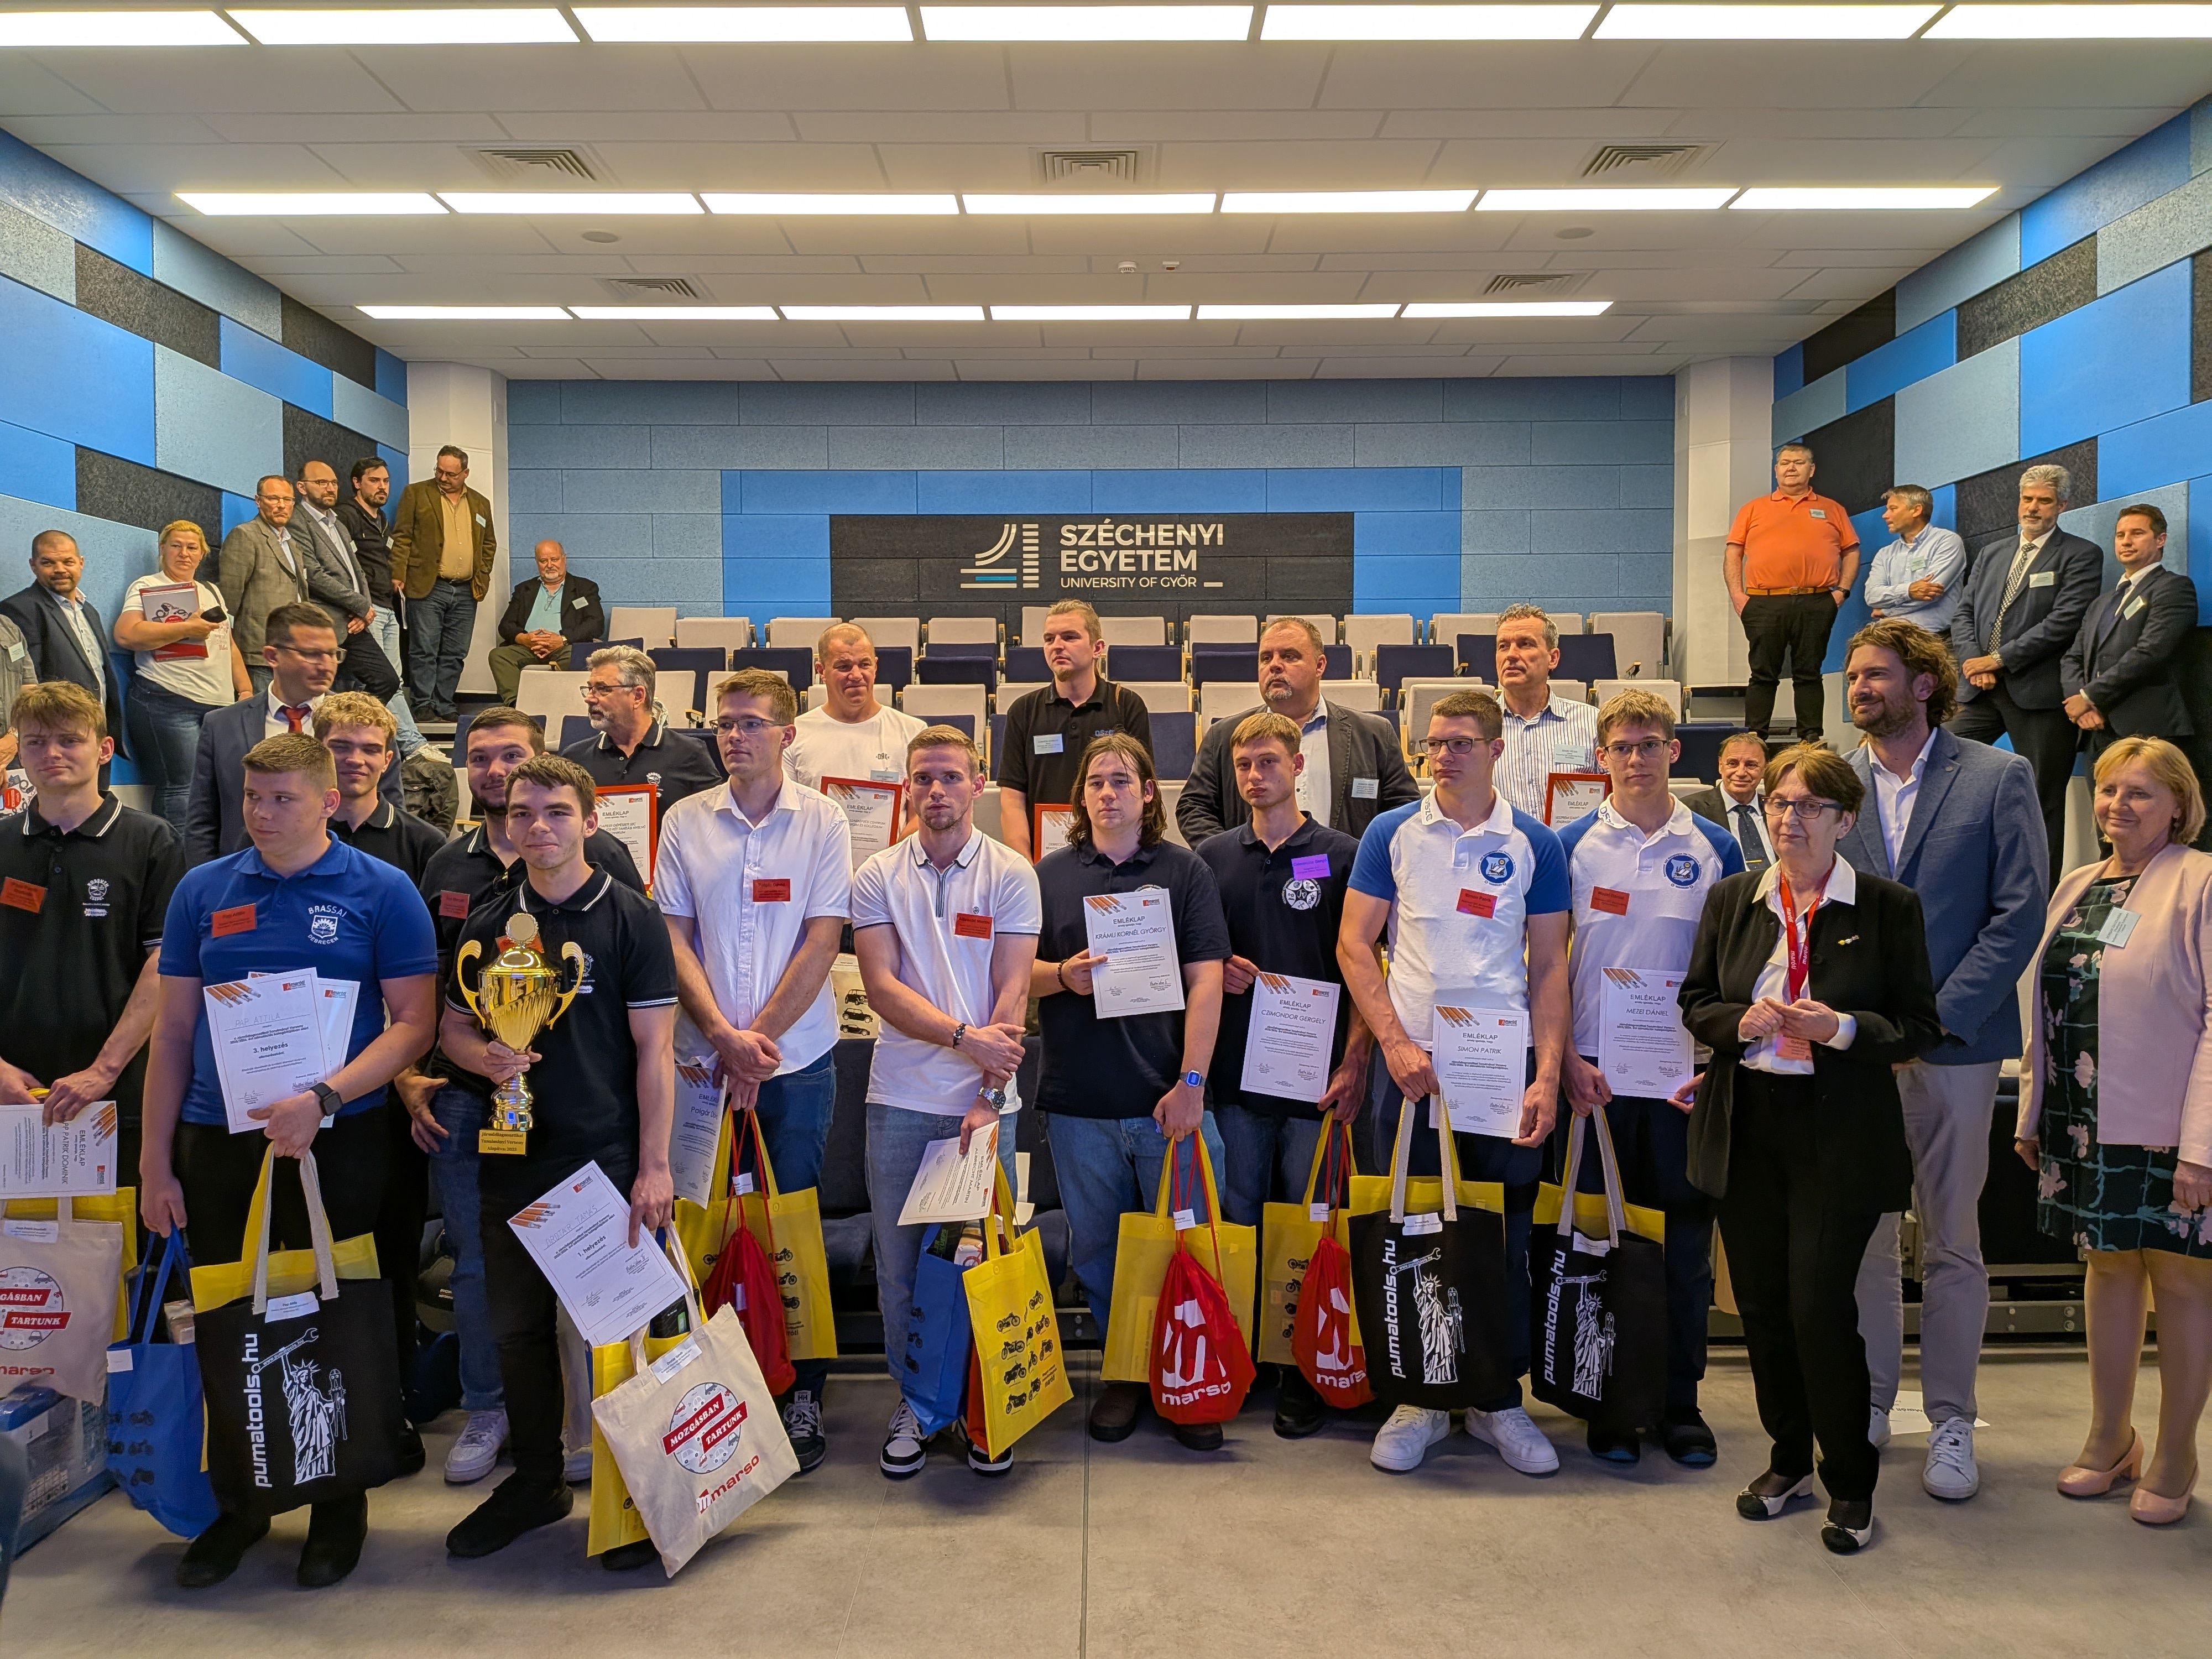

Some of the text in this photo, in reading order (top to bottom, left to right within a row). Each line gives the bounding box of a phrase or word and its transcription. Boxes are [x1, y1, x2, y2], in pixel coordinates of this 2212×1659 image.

[1060, 518, 1223, 546] SZÉCHENYI
[1061, 550, 1197, 571] EGYETEM
[1061, 574, 1197, 588] UNIVERSITY OF GYŐR
[308, 905, 347, 917] BRASSAI
[1113, 916, 1145, 925] EMLÉKLAP
[307, 934, 339, 945] DEBRECEN
[1117, 929, 1140, 938] KORNÉL
[1279, 999, 1311, 1009] EMLÉKLAP
[1261, 1009, 1327, 1024] CZIMONDOR GERGELY
[260, 1042, 288, 1052] helyezés
[964, 1147, 978, 1203] ALBRECHT MARTIN
[583, 1235, 607, 1254] helyezés
[11, 1317, 61, 1326] TARTUNK
[1317, 1369, 1366, 1390] mars
[1162, 1381, 1232, 1406] marso
[669, 1400, 720, 1447] MOZGÁSBAN
[706, 1409, 743, 1446] TARTUNK
[711, 1455, 760, 1503] marso
